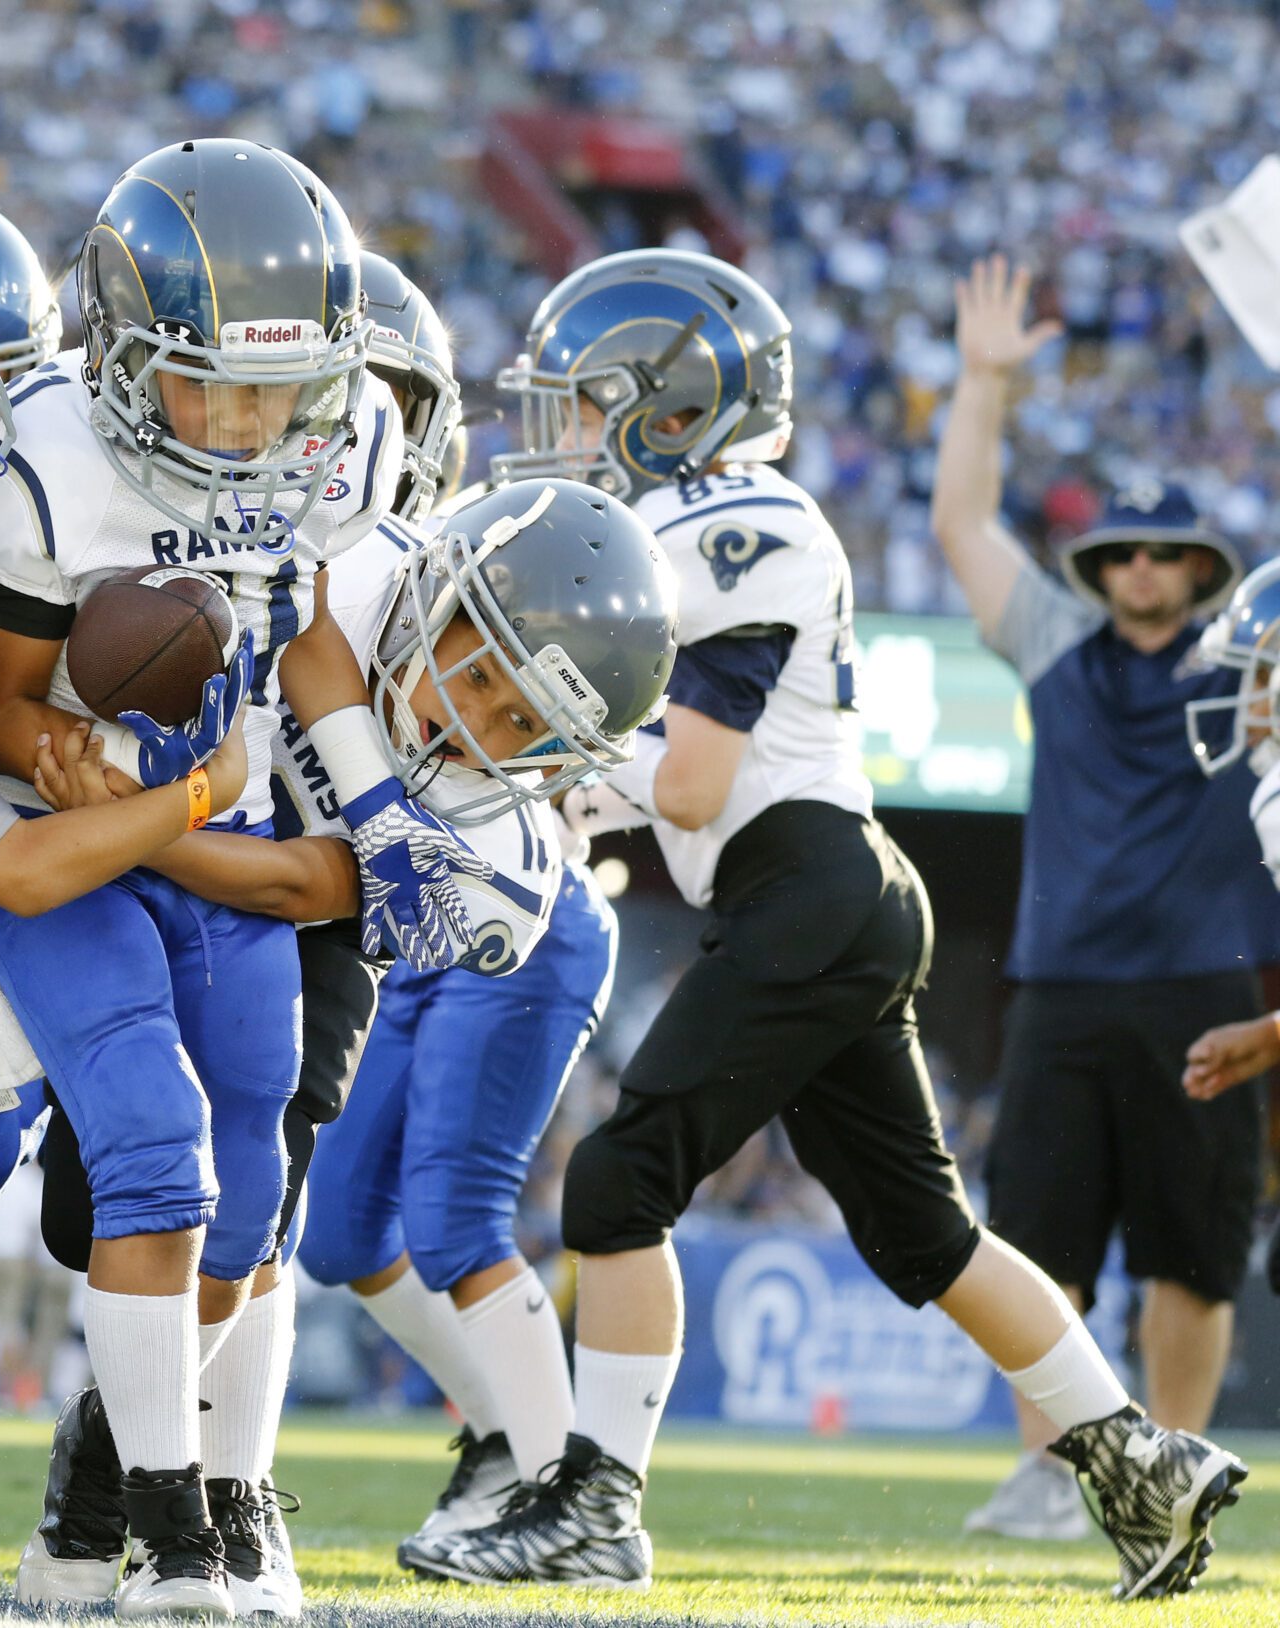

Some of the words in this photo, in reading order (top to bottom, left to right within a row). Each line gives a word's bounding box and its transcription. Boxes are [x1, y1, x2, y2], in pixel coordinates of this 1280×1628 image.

[244, 325, 301, 343] Riddell
[112, 362, 157, 418] Ridell
[558, 668, 587, 700] schutt
[279, 694, 341, 821] AMS
